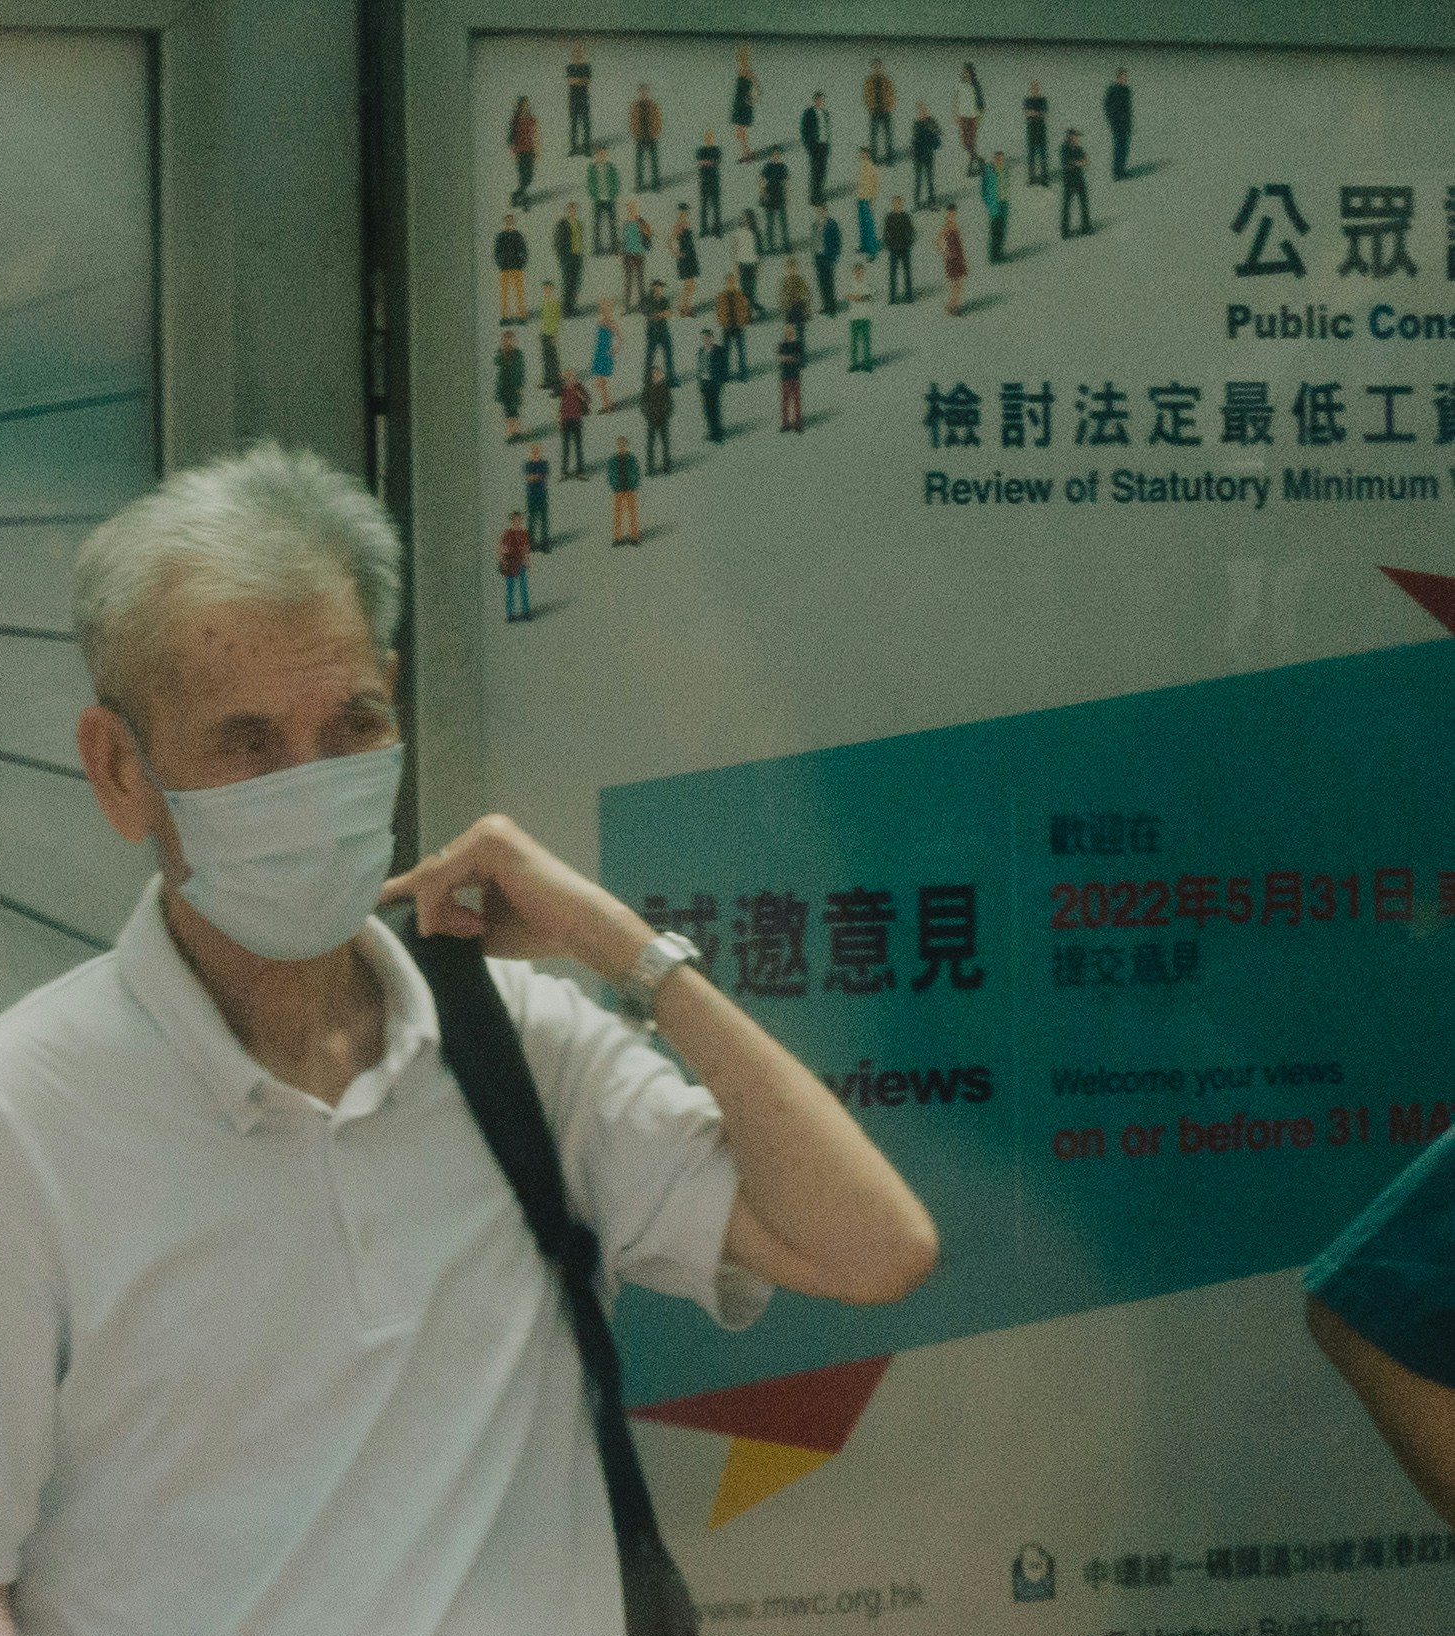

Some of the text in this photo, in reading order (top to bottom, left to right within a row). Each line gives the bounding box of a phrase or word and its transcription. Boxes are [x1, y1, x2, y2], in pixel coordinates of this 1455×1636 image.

[1229, 182, 1455, 281] 公眾
[1226, 303, 1355, 341] Public
[924, 465, 1439, 511] Review of Statutory Minimum
[1050, 1058, 1345, 1098] Welcome your views
[1051, 1099, 1455, 1161] on or before 31 MA
